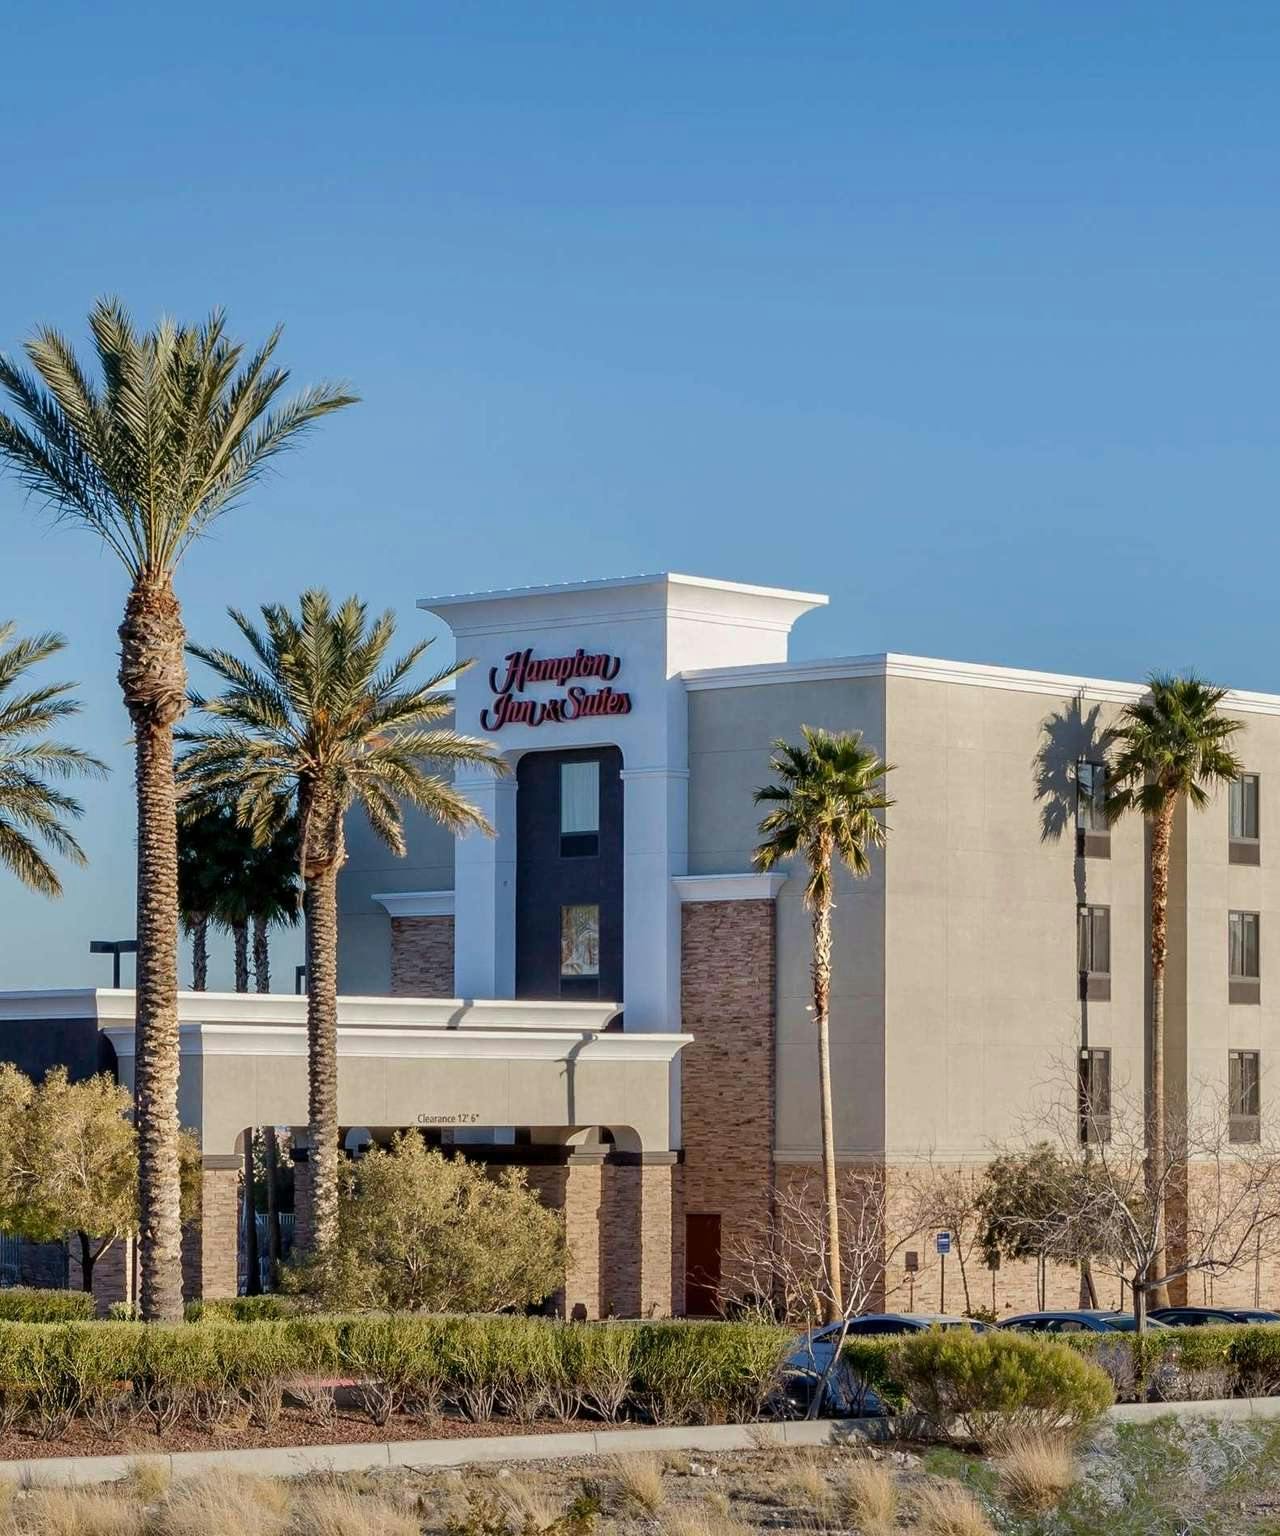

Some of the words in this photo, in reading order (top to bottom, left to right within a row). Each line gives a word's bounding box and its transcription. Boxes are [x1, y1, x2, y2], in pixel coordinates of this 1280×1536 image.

[489, 648, 621, 694] Hampton
[480, 693, 545, 731] Inn
[560, 686, 632, 720] Suites
[417, 1114, 456, 1123] Clearance
[458, 1114, 469, 1123] 12'
